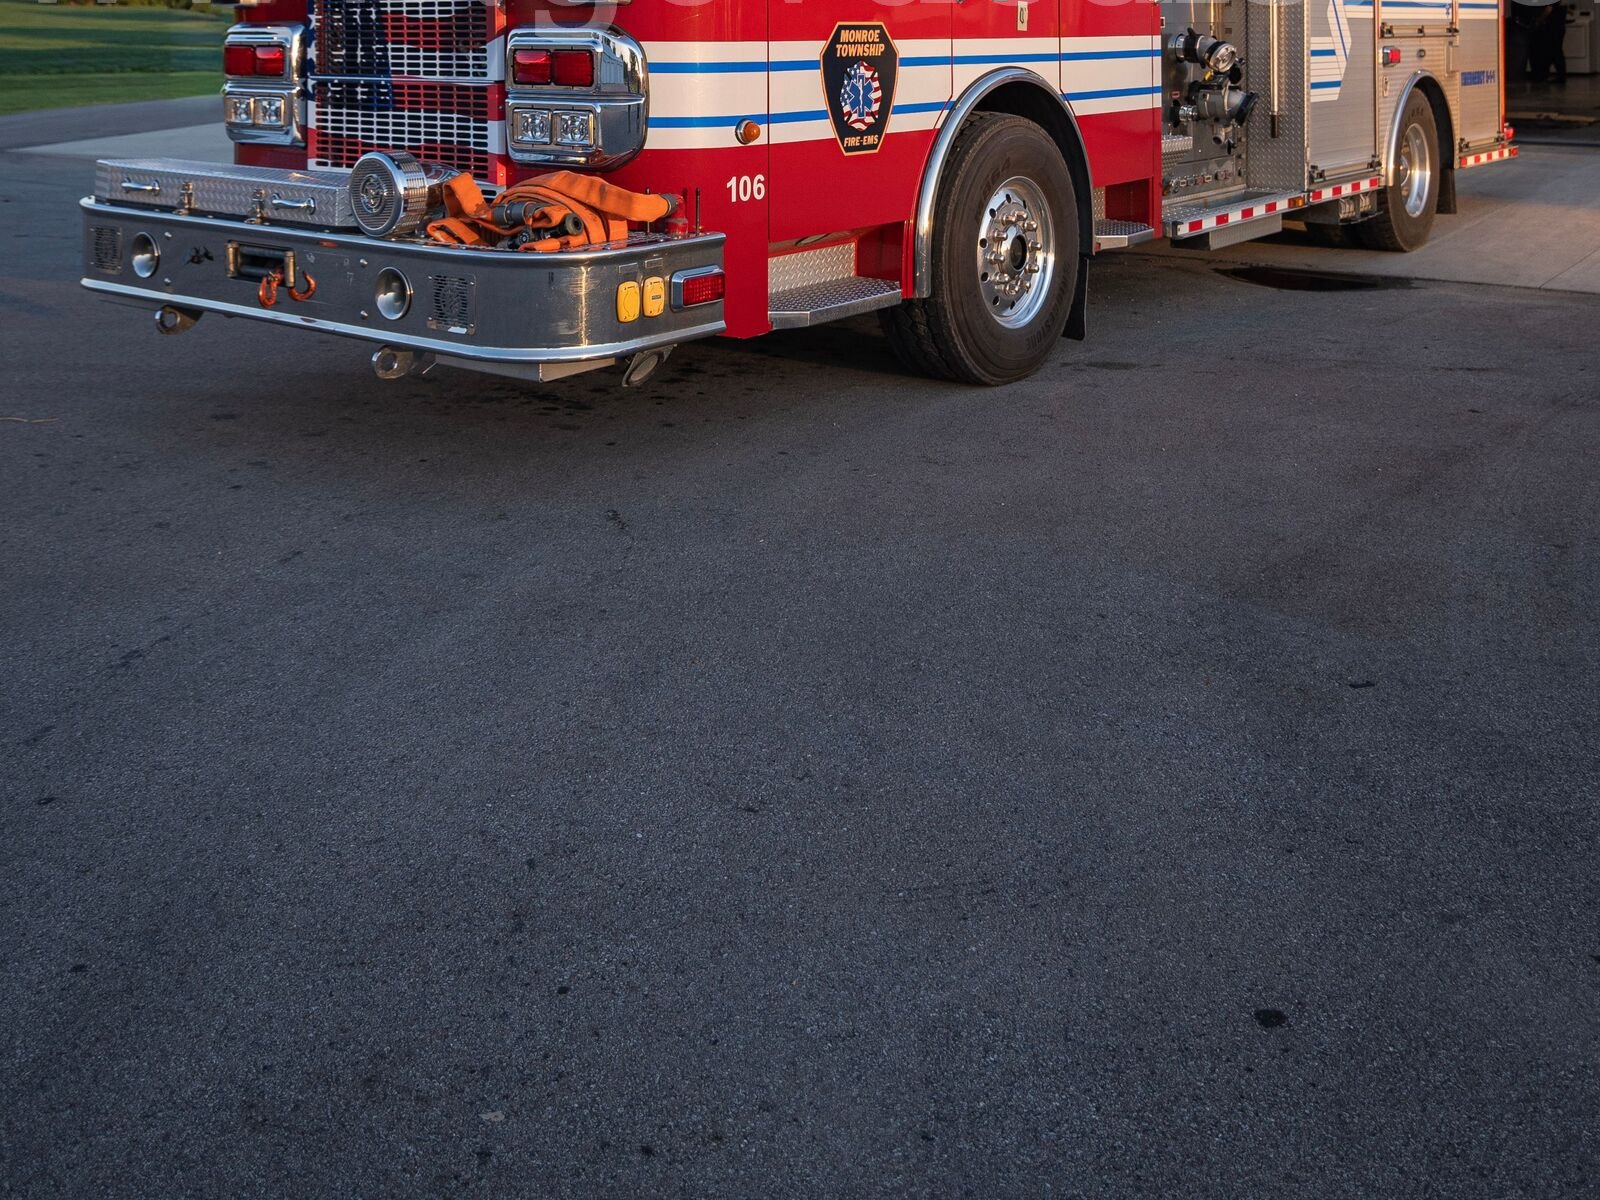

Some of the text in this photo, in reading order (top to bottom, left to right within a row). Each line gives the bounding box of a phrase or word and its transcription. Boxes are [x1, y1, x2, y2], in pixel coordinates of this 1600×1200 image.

[840, 29, 881, 43] MONROE
[836, 43, 885, 58] TOWNSHIP
[843, 134, 879, 148] FIRE-EMS
[726, 174, 766, 203] 106
